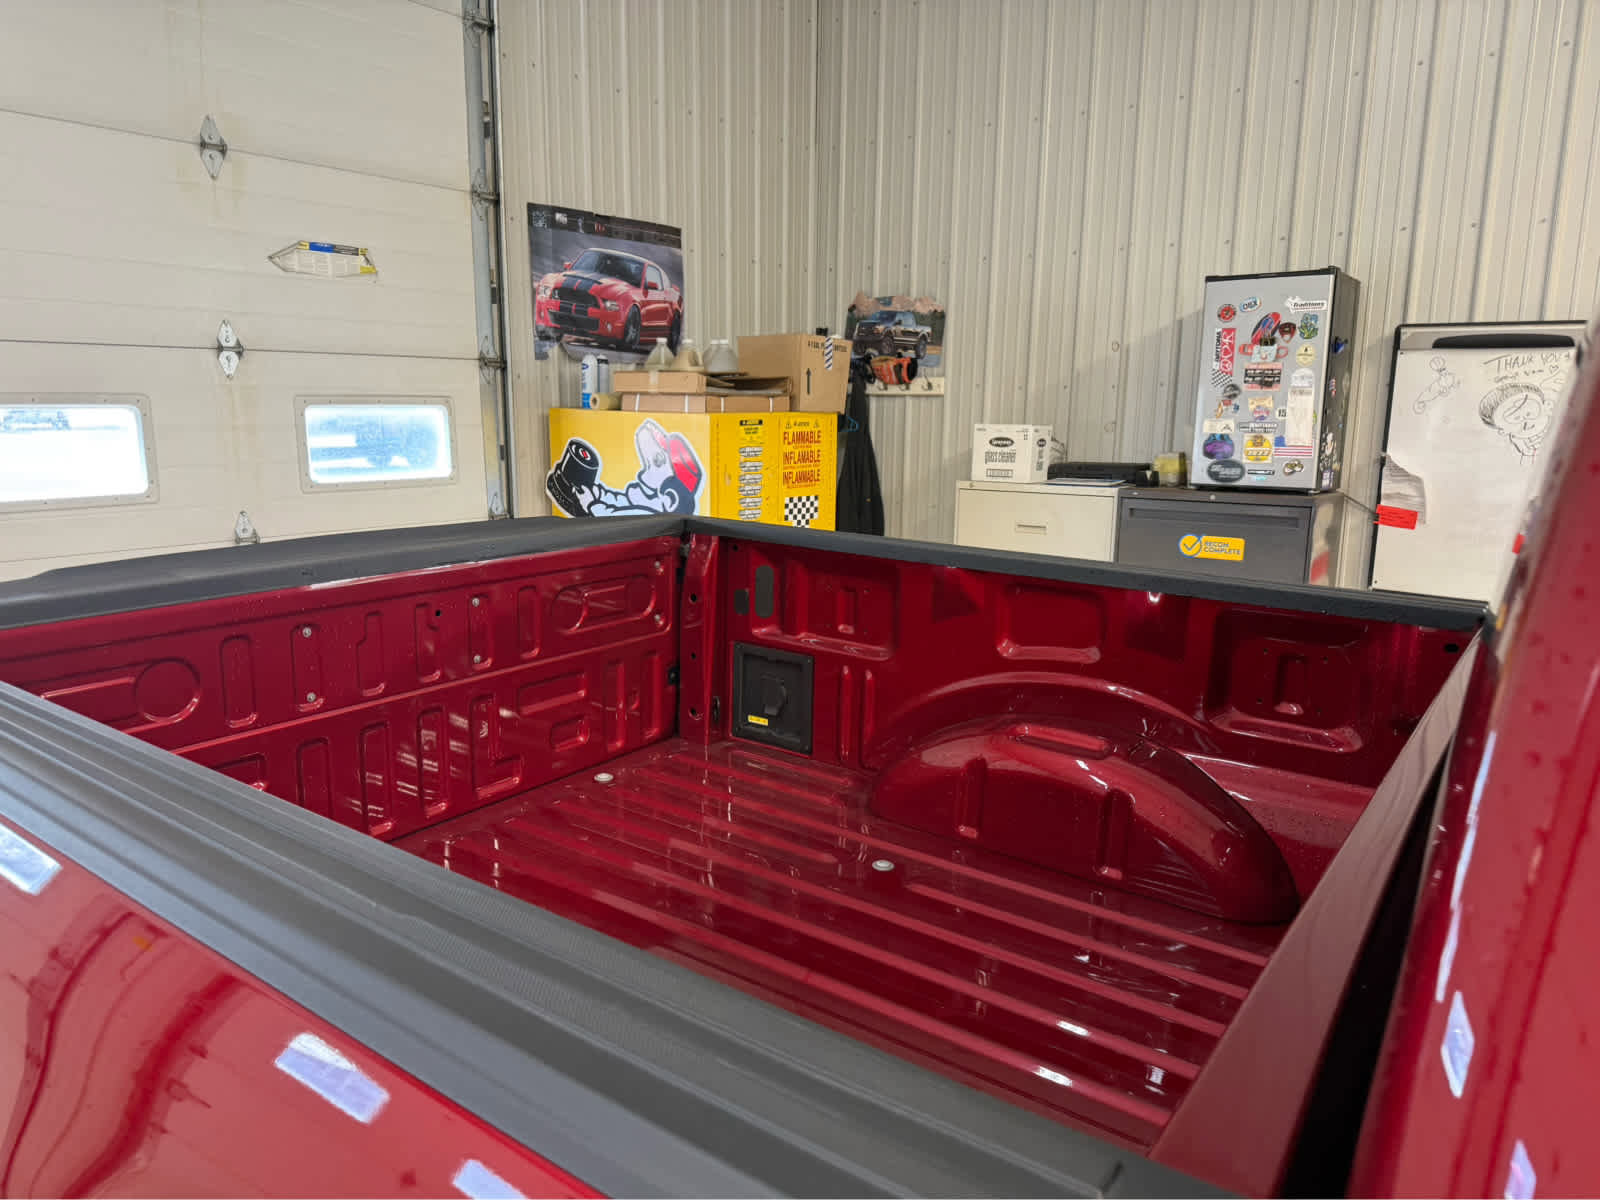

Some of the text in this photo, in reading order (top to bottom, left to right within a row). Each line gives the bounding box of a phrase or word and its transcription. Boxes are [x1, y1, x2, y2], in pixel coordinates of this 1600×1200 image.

[1483, 354, 1533, 374] THANK
[783, 430, 821, 445] FLAMMABLE
[985, 450, 1016, 464] glass cleaner
[1204, 547, 1241, 555] COMPLETE
